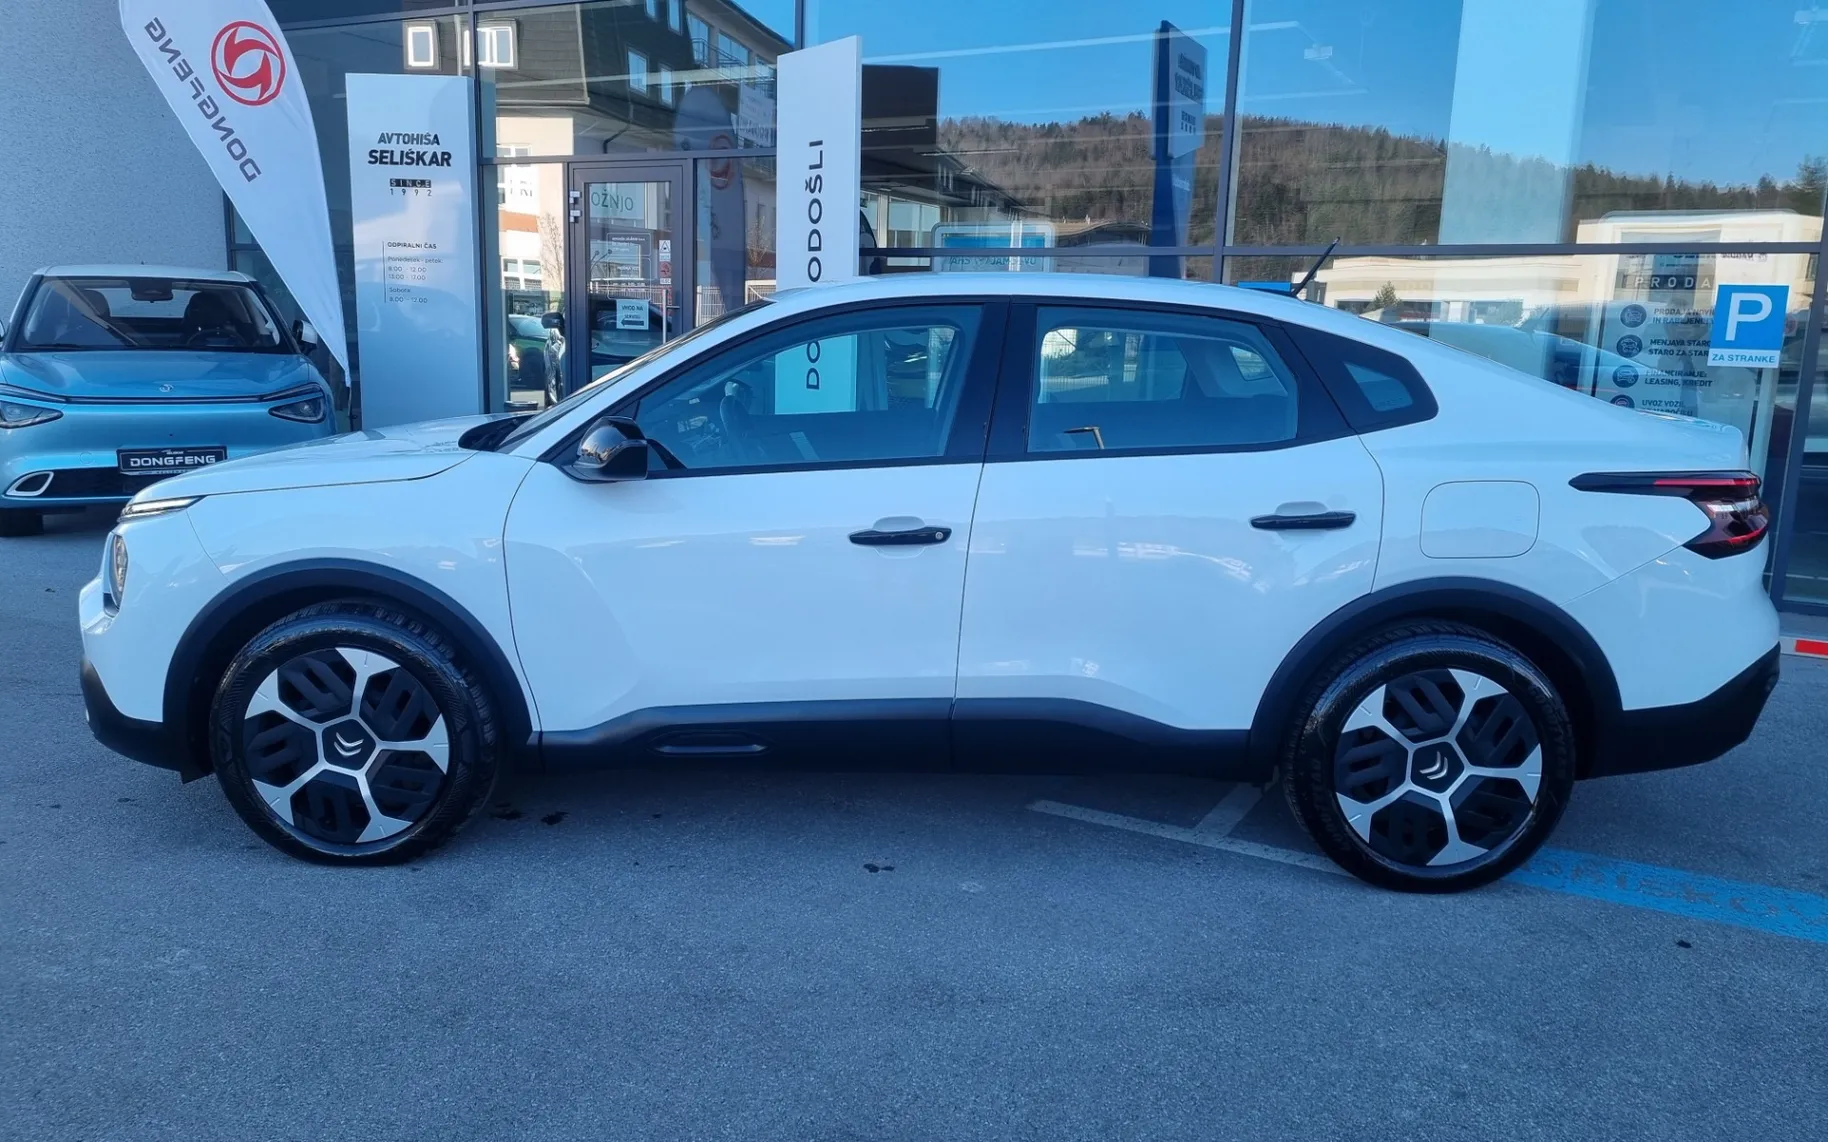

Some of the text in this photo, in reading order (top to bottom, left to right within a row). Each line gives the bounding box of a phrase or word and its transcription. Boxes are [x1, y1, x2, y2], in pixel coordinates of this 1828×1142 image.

[377, 131, 441, 146] AVTOHIŠA
[367, 148, 452, 168] SELIŠKAR
[390, 179, 431, 188] SINCE
[390, 188, 432, 197] 1992
[387, 241, 437, 250] ODPIRALNI ČAS
[1724, 292, 1773, 342] P
[1649, 338, 1686, 347] MENJAVA
[1648, 348, 1675, 356] STARO
[1711, 353, 1776, 364] ZA STRANKE
[1644, 378, 1681, 387] LEASING,
[1641, 399, 1664, 407] UVOZ
[130, 455, 216, 467] DONGFENG
